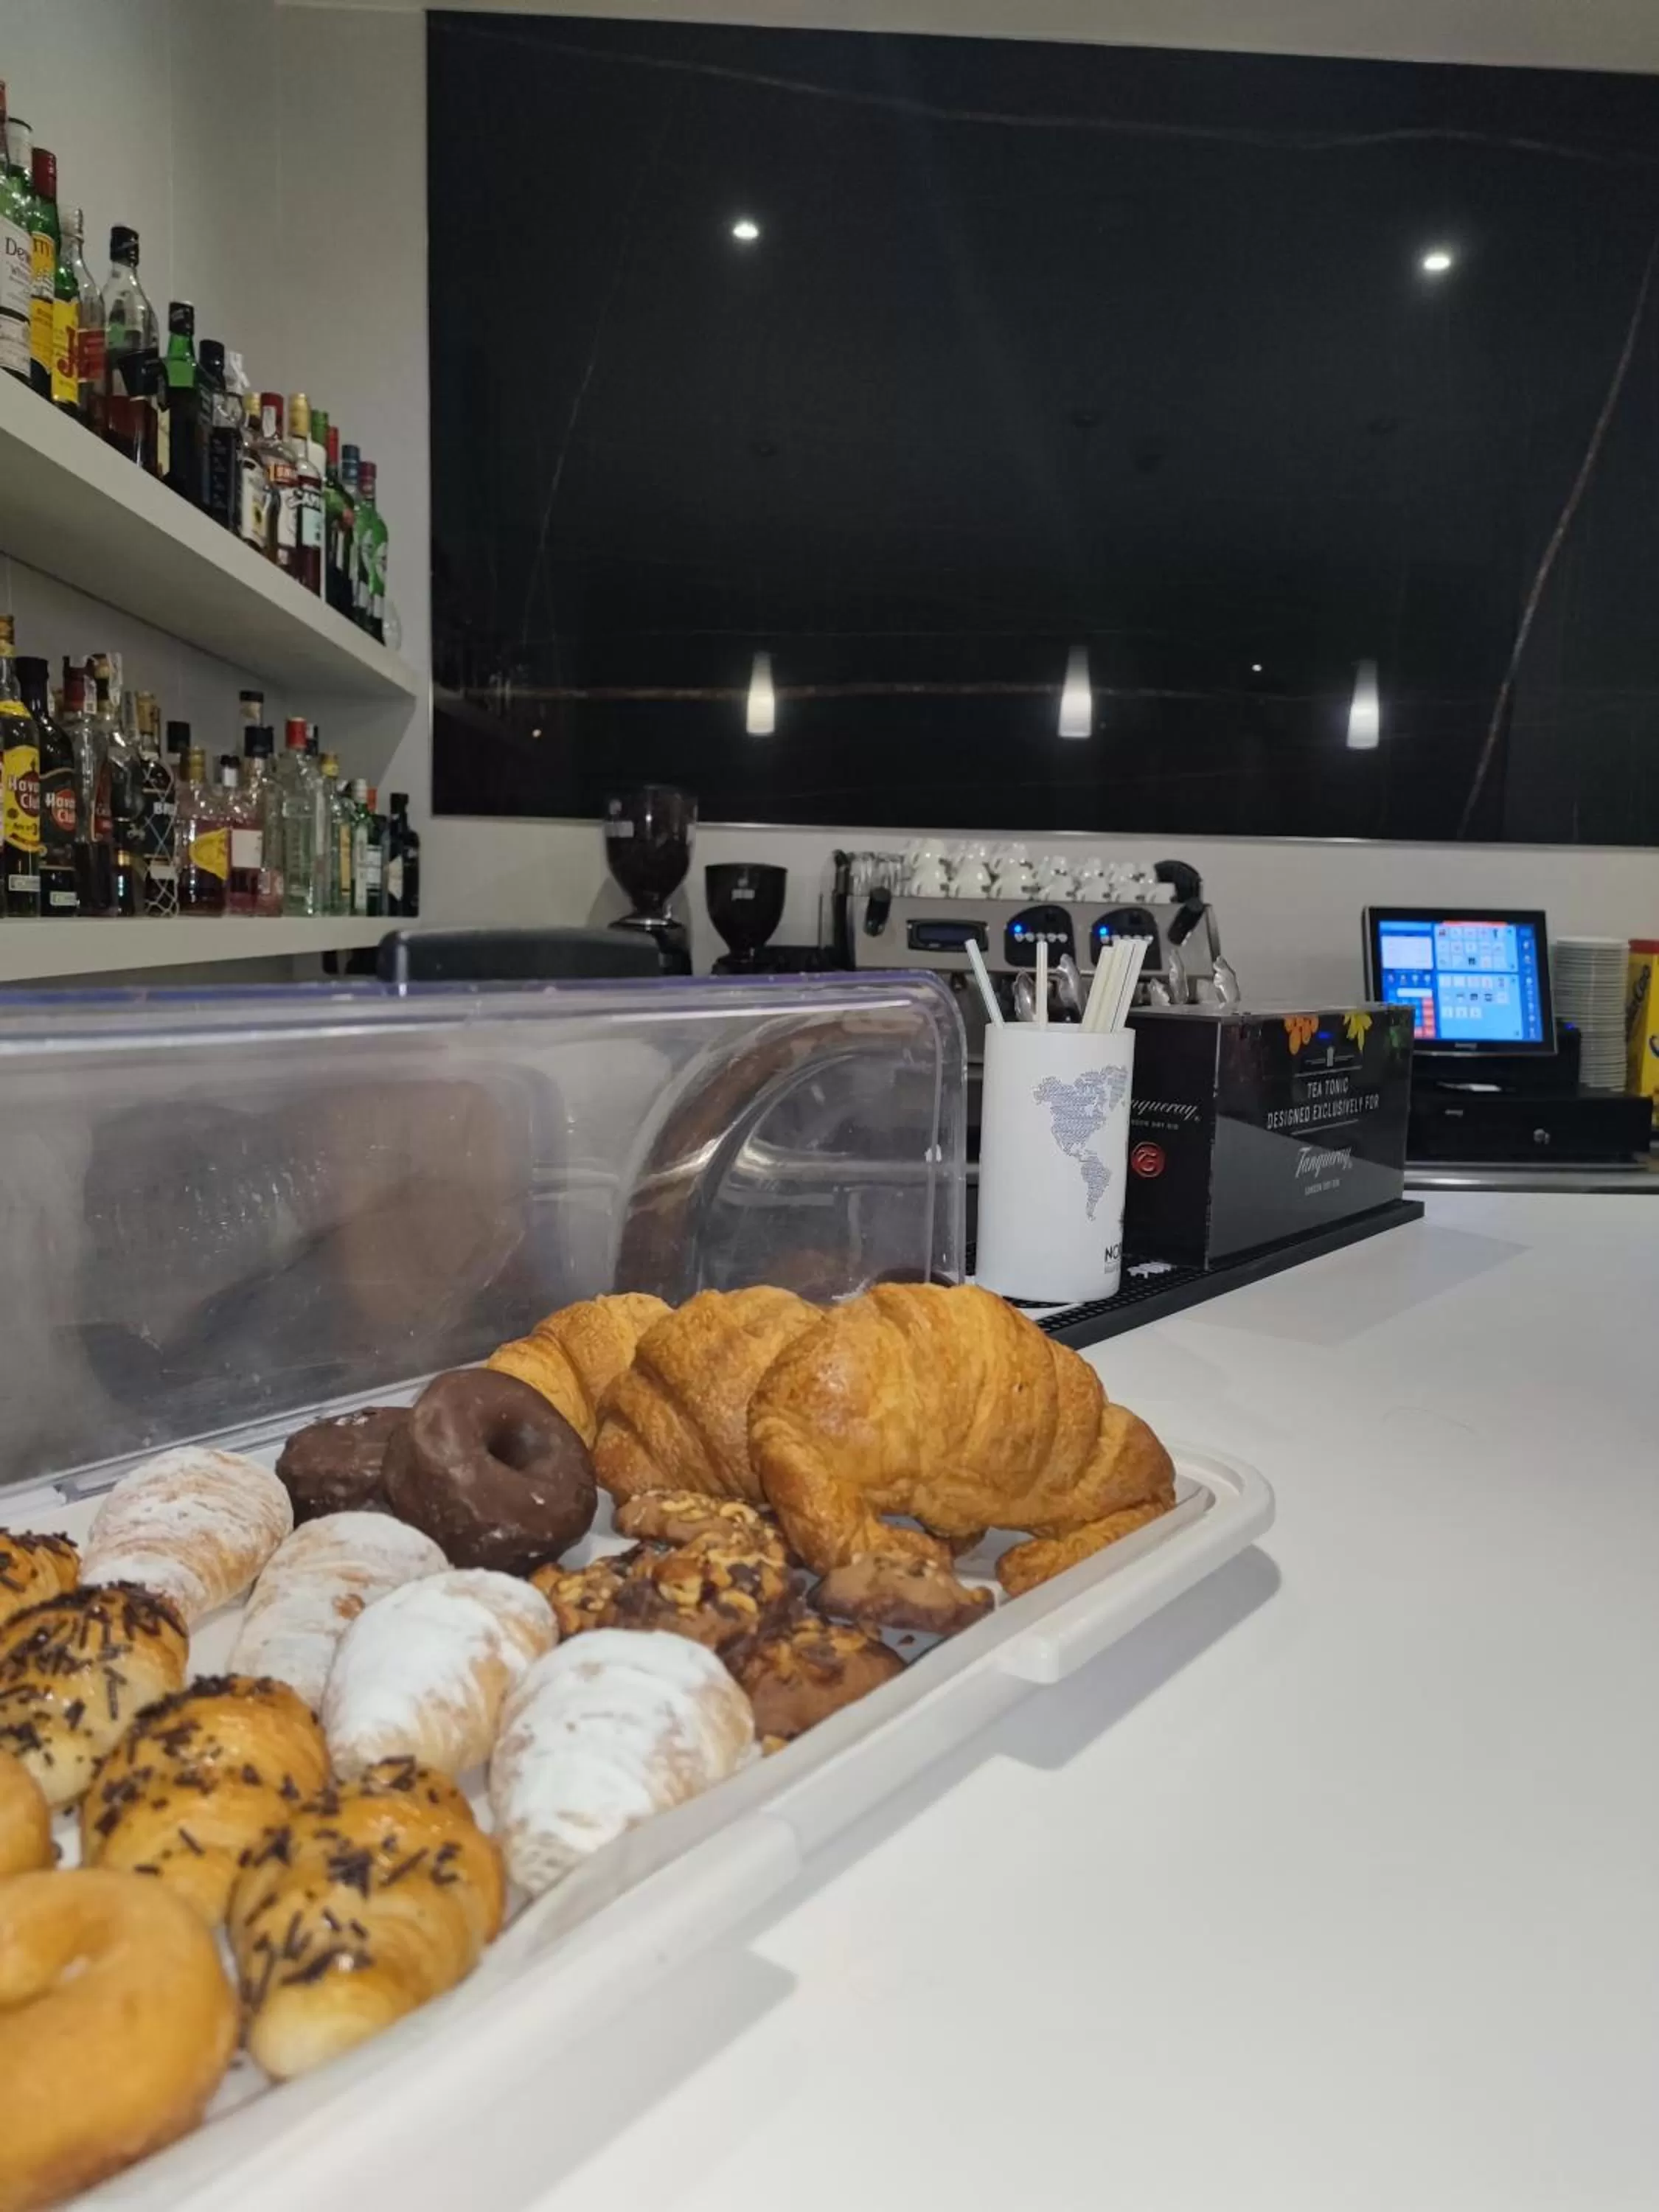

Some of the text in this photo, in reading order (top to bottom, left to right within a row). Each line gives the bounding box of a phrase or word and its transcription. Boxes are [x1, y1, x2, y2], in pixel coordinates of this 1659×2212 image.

[1307, 1077, 1349, 1099] TEA TONIC
[1267, 1093, 1380, 1130] DESIGNED EXCLUSIVELY FOR
[1295, 1146, 1352, 1178] Tanqueray
